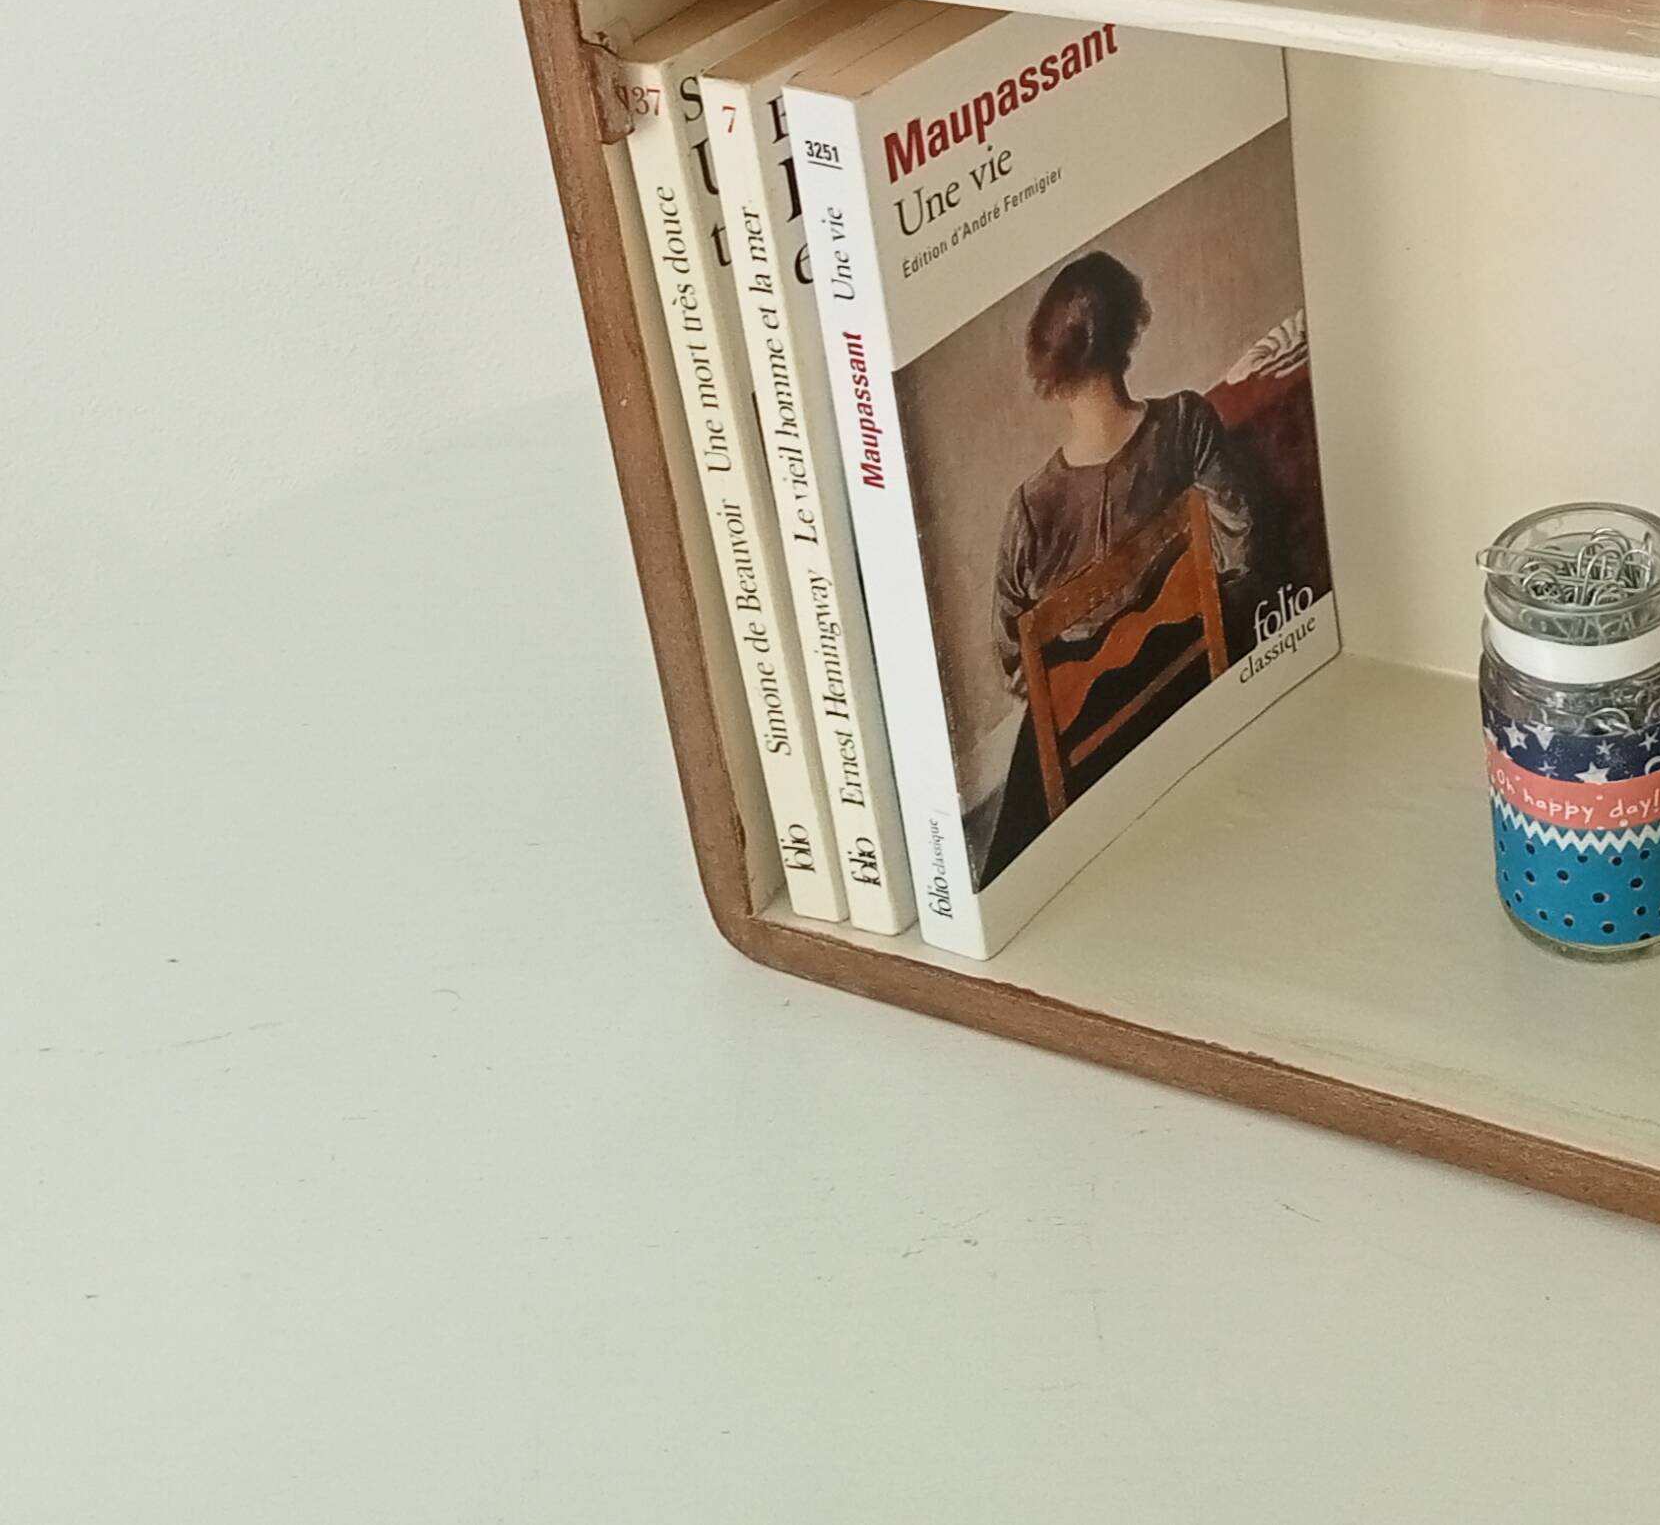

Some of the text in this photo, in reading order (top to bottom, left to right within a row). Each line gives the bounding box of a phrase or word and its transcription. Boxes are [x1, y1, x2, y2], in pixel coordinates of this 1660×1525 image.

[722, 105, 737, 134] 7
[883, 23, 1119, 185] Maupassant
[804, 139, 840, 164] 3251
[894, 145, 1014, 237] Une vie
[951, 203, 1001, 247] d'André
[1004, 167, 1063, 213] Fermigier
[655, 186, 816, 874] folio Simone de Beauvoir Une mort très douce
[741, 206, 882, 888] folio Ernest Hemingway Le vieil homme et la mer
[821, 206, 954, 920] folio classique Maupassant Une vie
[1239, 616, 1316, 684] classique
[1253, 583, 1314, 646] folio
[1496, 768, 1660, 824] Oh happy day!
